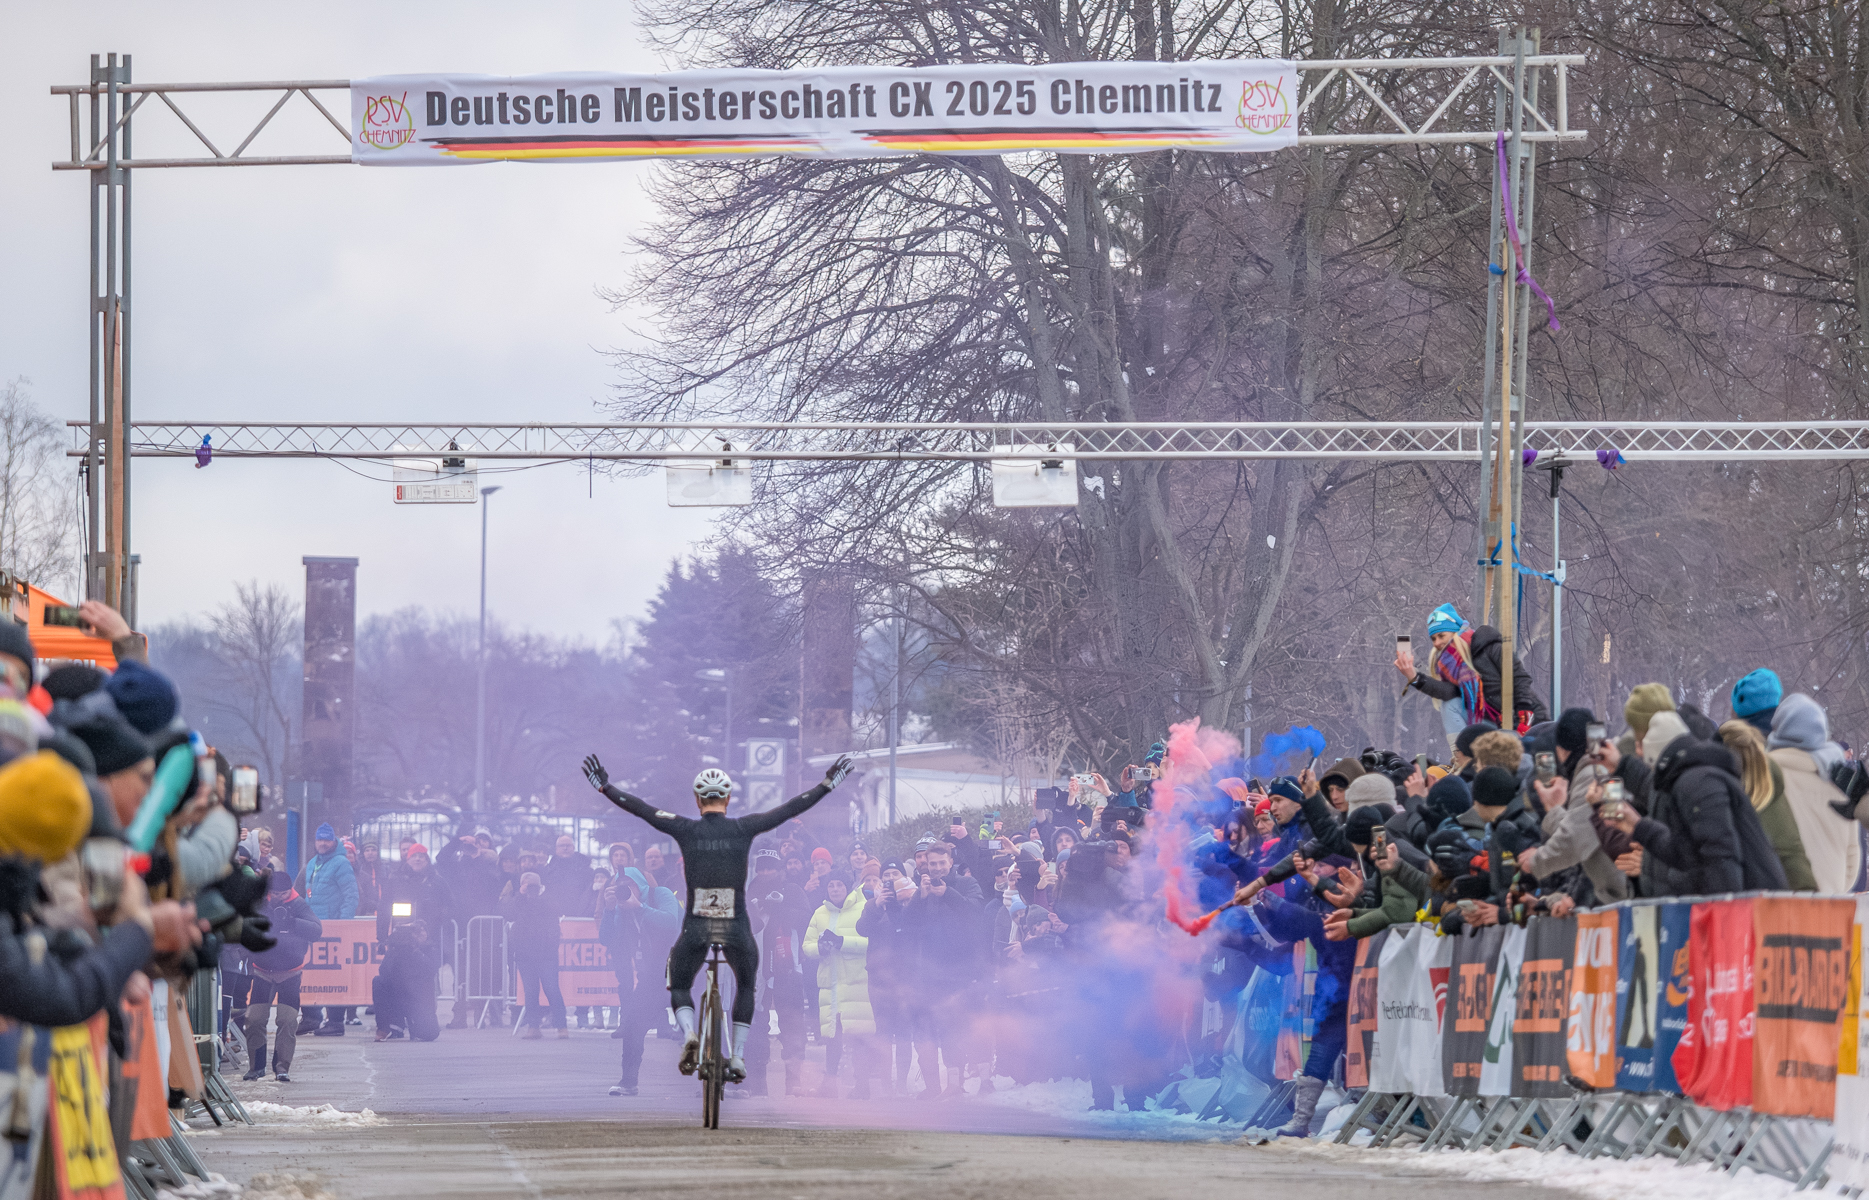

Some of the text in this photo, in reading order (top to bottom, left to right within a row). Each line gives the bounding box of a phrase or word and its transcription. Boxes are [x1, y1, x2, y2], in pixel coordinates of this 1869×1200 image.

[426, 77, 1222, 127] Deutsche Meisterschaft CX 2025 Chemnitz
[1242, 76, 1283, 111] RSV
[366, 91, 407, 127] RSV
[1235, 114, 1292, 128] CHEMNITZ
[359, 129, 416, 144] CHEMNITZ
[709, 894, 719, 907] 2
